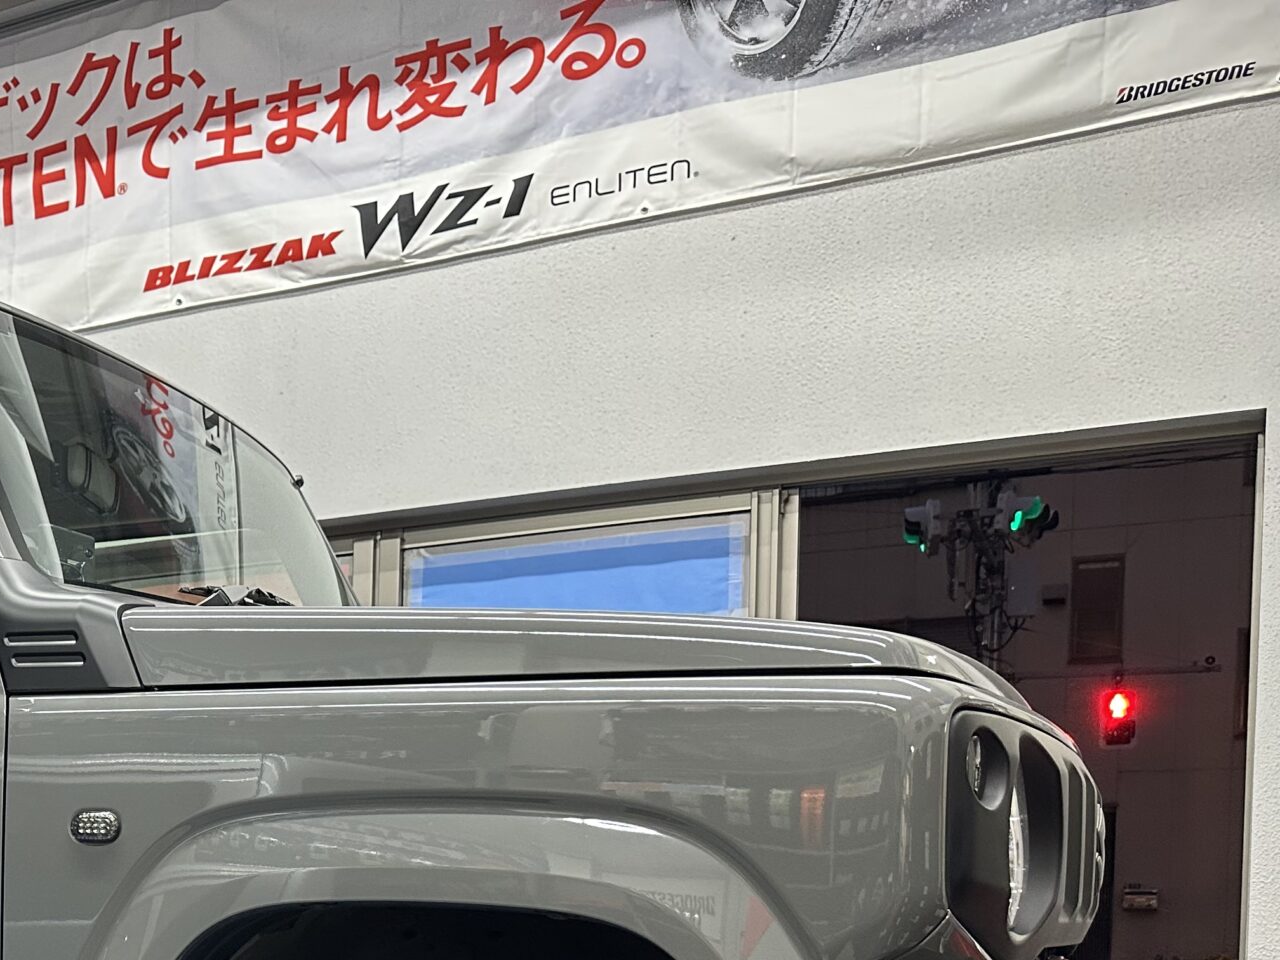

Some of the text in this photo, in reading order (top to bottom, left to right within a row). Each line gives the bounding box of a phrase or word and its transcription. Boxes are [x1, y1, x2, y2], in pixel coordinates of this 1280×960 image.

[1115, 61, 1257, 105] BRIDGESTONE
[142, 230, 342, 292] BLIZZAK
[352, 173, 535, 261] WZ-1
